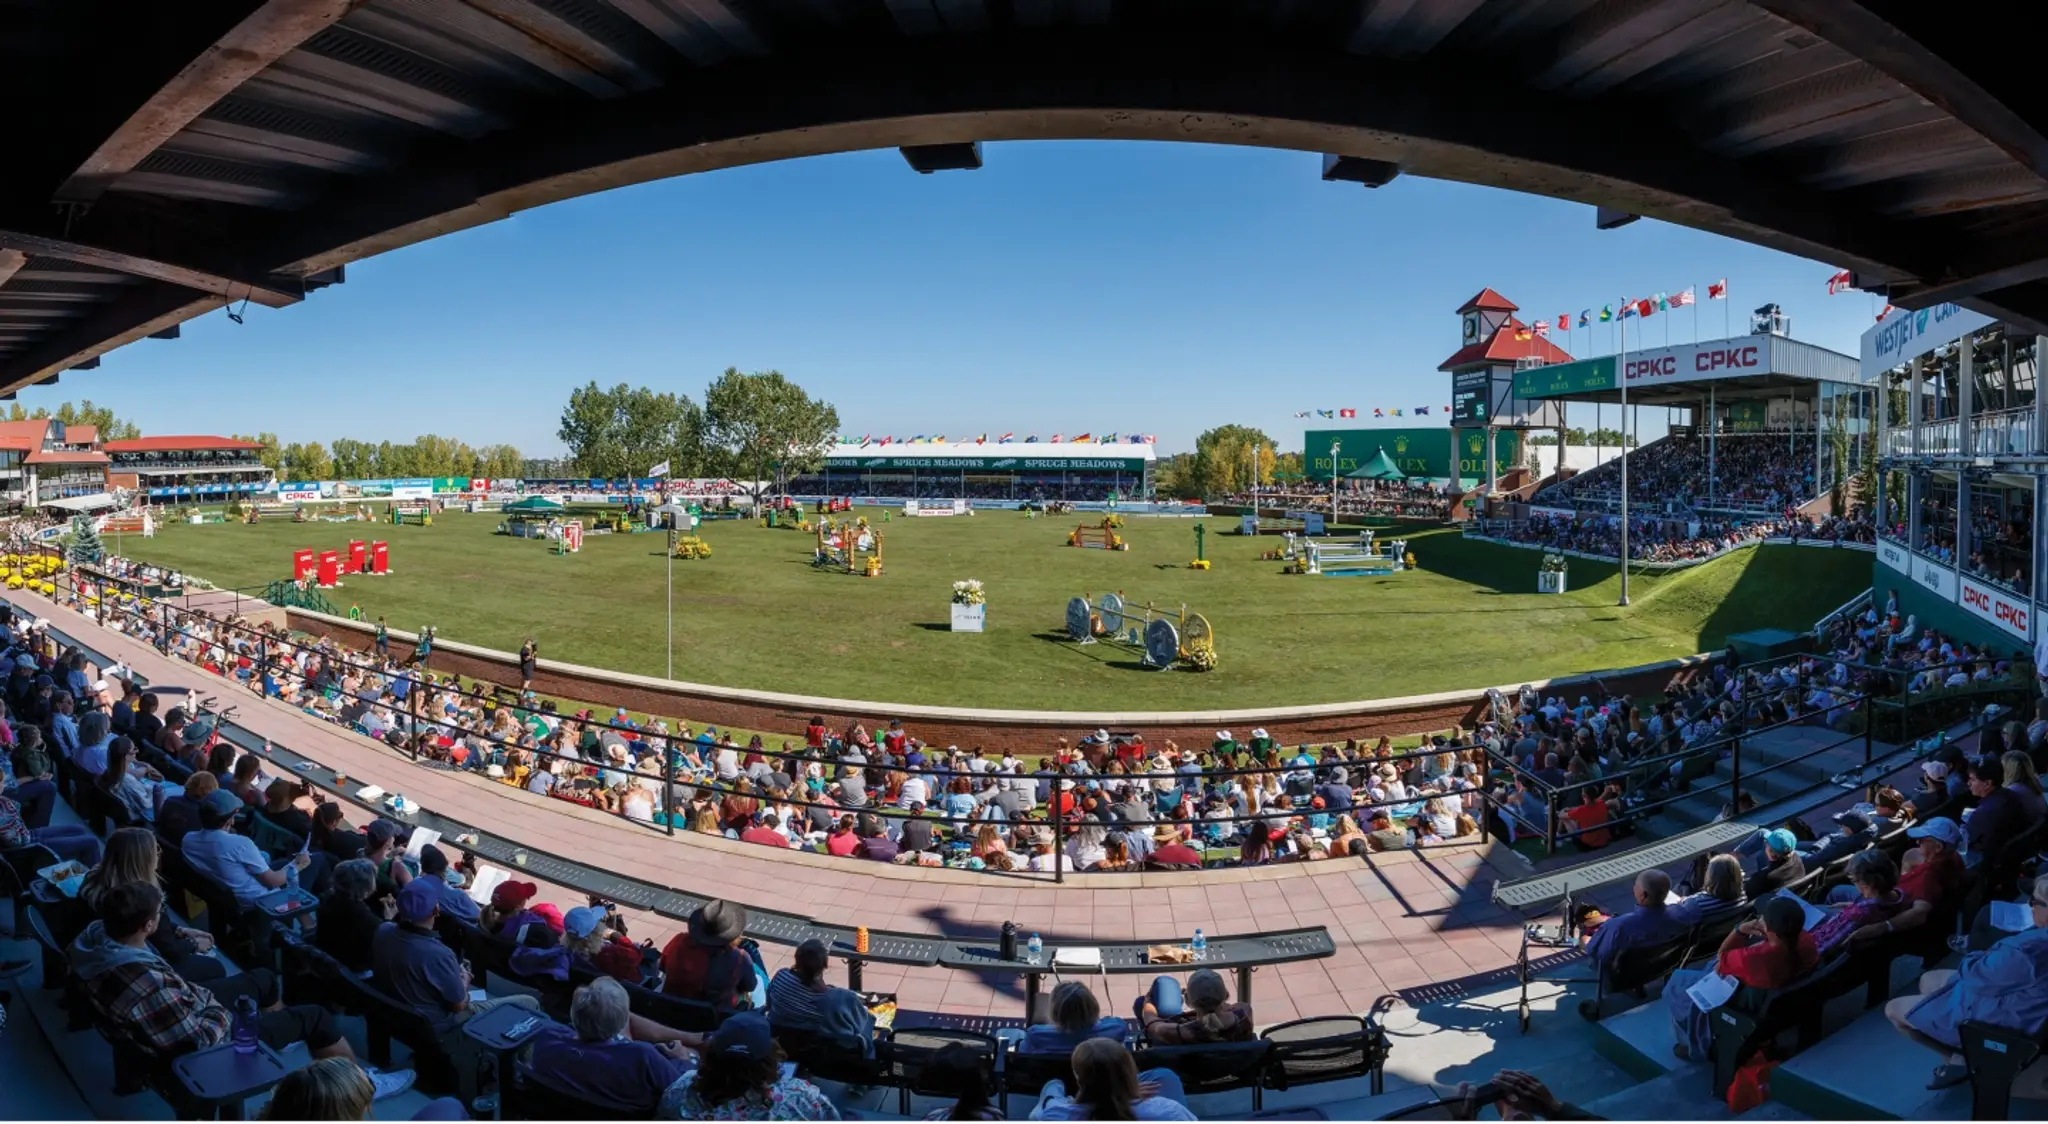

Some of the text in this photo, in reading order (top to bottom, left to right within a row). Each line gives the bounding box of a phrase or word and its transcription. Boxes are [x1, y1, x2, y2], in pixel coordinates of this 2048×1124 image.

[1875, 311, 1914, 357] WESTJET
[1625, 346, 1758, 379] CPKC CPKC
[1584, 376, 1607, 387] ROLEX
[892, 458, 985, 467] SPRUCE MEADOWS
[1025, 459, 1126, 468] SPRUCE MEADOWS
[1315, 458, 1357, 470] ROEX
[285, 492, 315, 500] CPKC
[1963, 585, 2027, 631] CPKC CPKC
